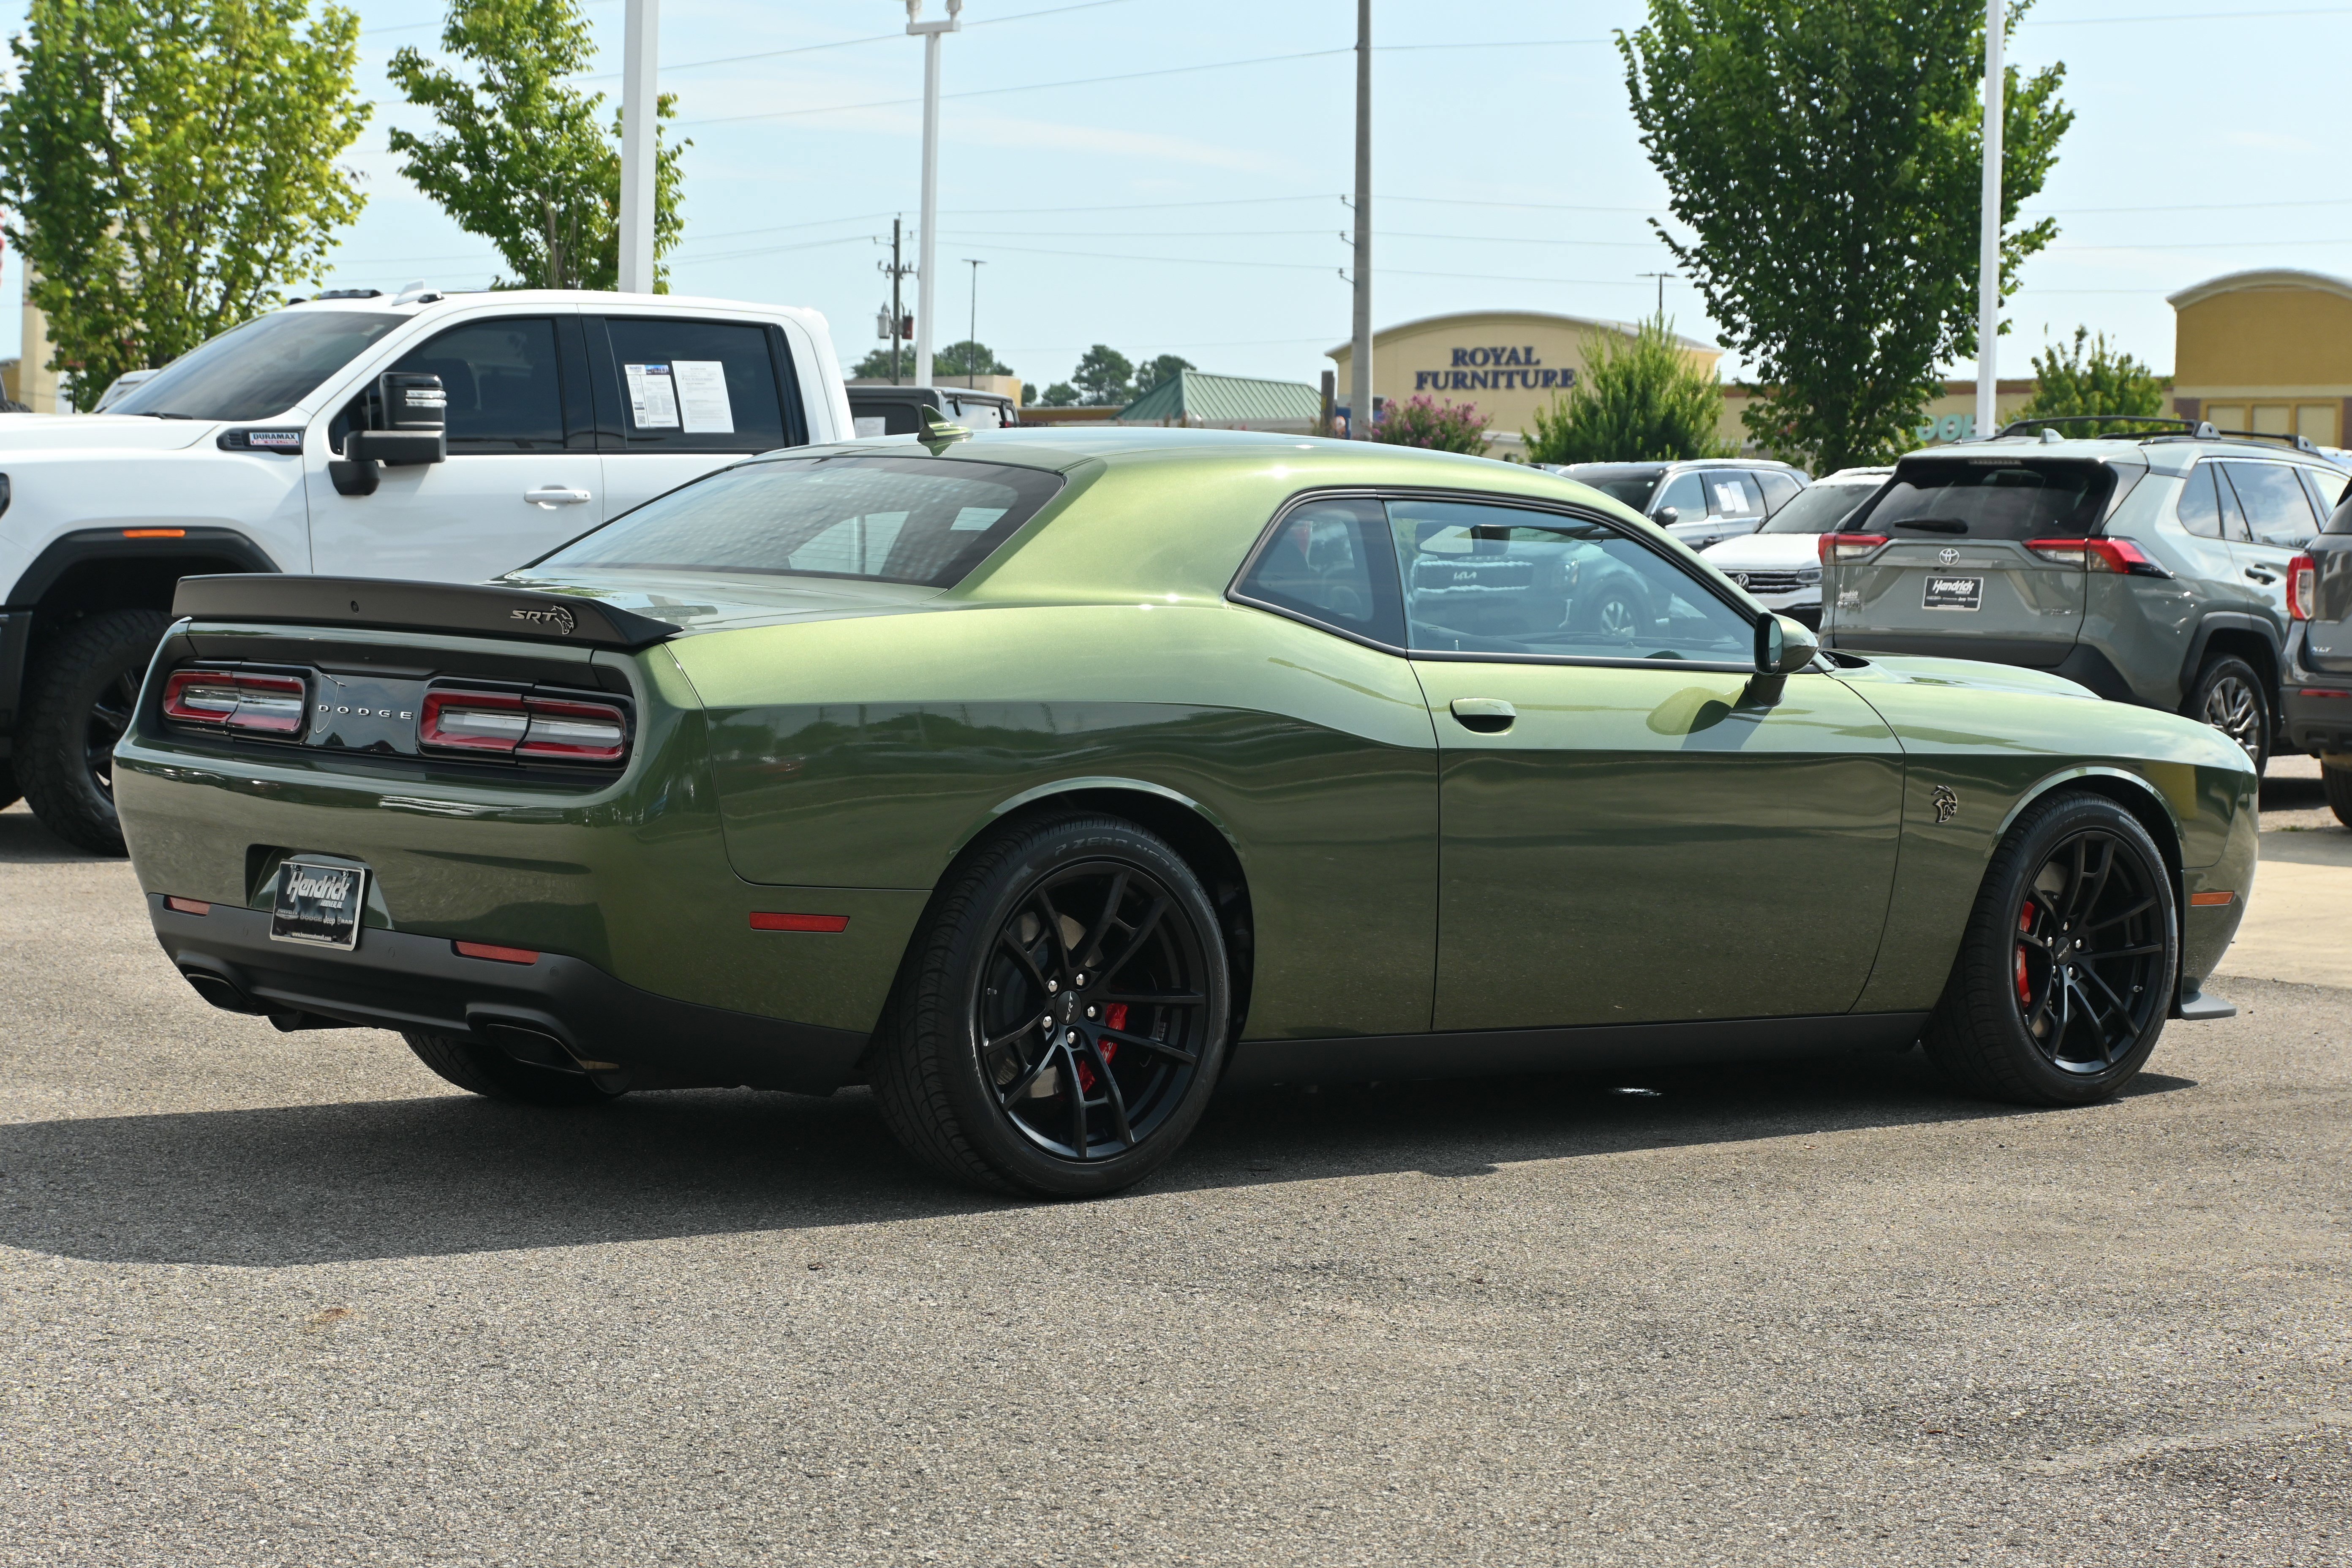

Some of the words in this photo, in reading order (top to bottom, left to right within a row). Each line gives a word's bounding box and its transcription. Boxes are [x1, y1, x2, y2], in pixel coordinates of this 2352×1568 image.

[1450, 346, 1541, 367] ROYAL
[1415, 368, 1576, 390] FURNITURE
[1933, 580, 1974, 594] Hendrick
[510, 610, 558, 624] SRT
[318, 705, 413, 719] DODGE
[1072, 836, 1128, 850] ZERO
[286, 871, 350, 903] Hendrick
[323, 915, 335, 926] Jeep
[2057, 942, 2070, 959] SRT
